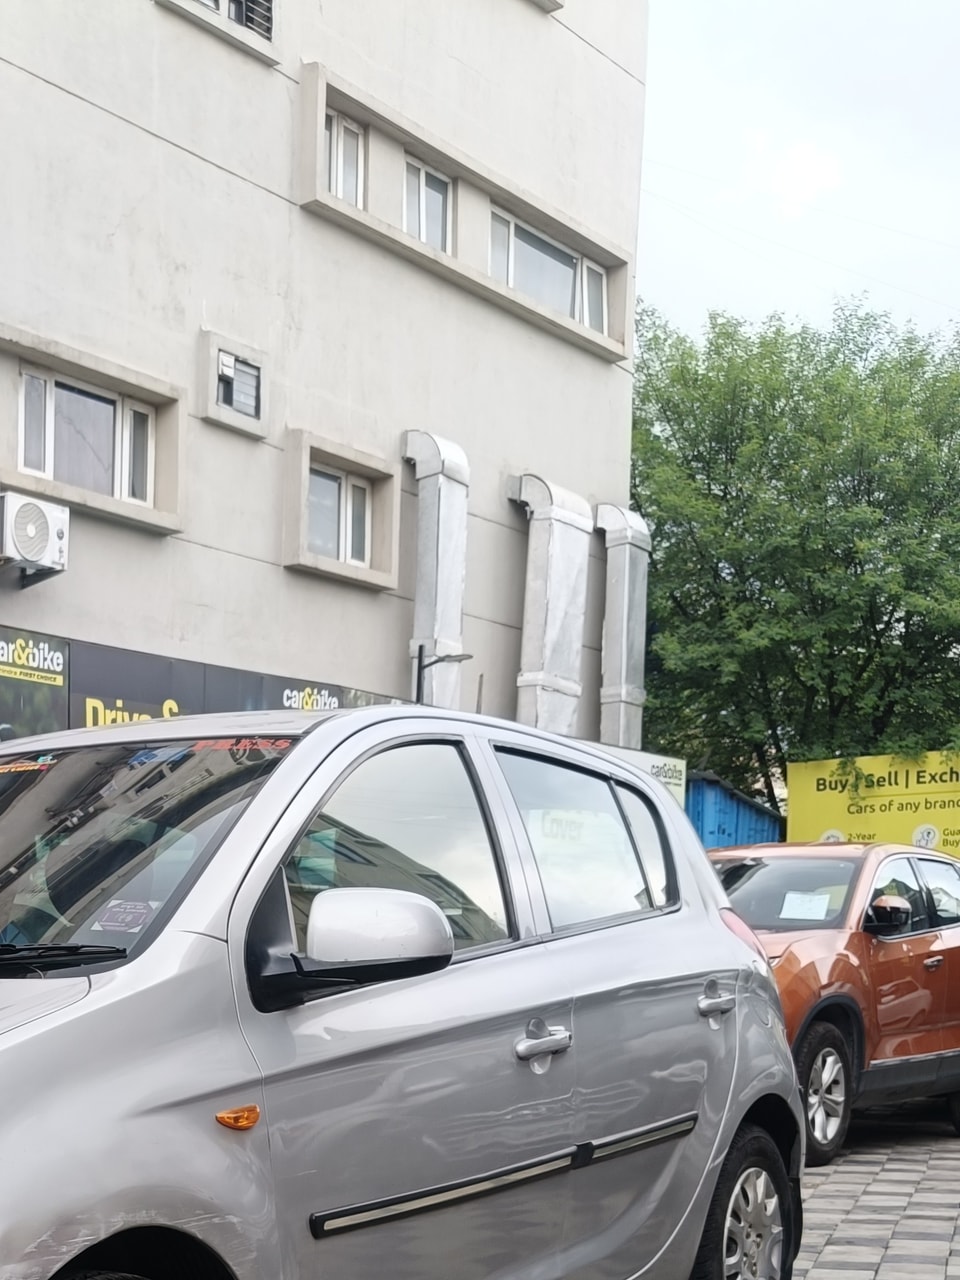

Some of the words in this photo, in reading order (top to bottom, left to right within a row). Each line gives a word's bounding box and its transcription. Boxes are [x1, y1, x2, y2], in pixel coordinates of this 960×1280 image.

[283, 687, 339, 710] car&bike
[816, 778, 849, 793] Buy
[864, 770, 899, 789] Sell
[916, 766, 960, 785] Exch
[847, 802, 876, 815] Cars
[879, 800, 894, 813] of
[897, 801, 921, 814] any
[848, 832, 877, 842] 2-Year
